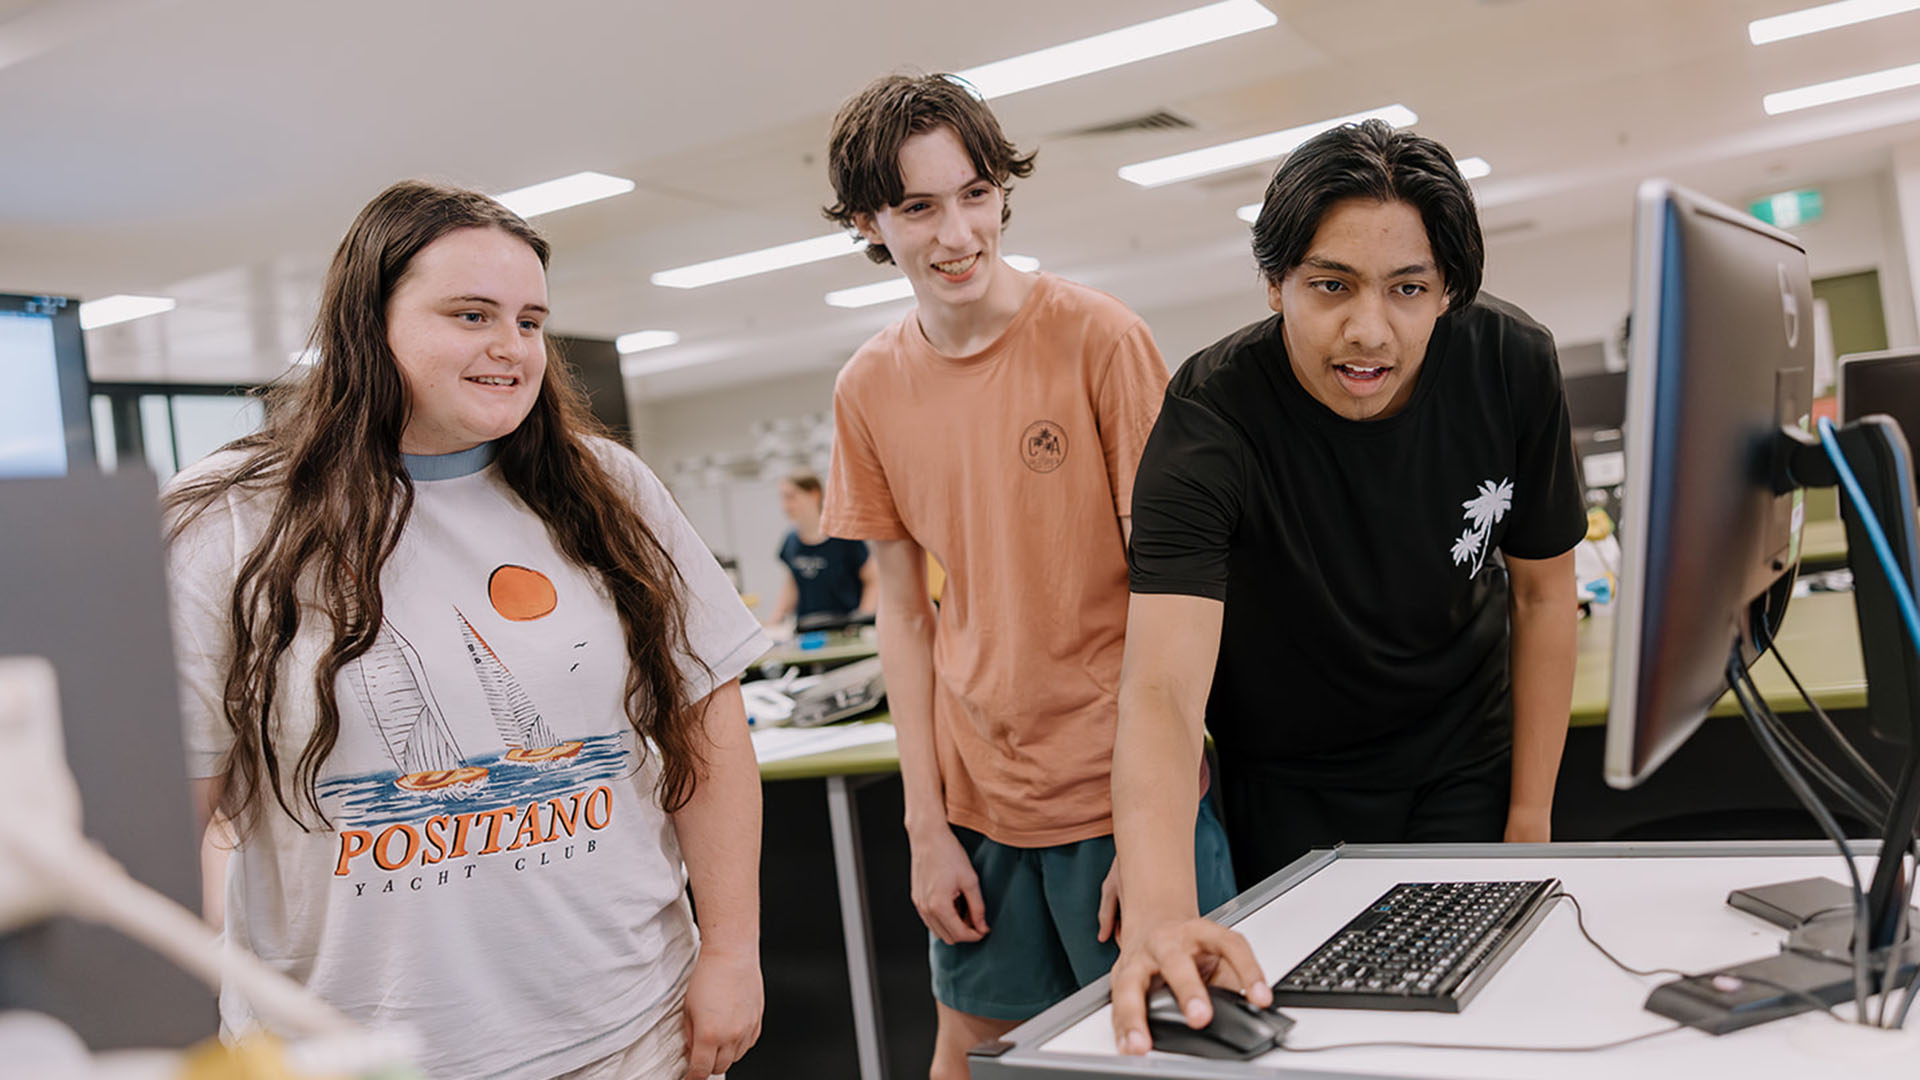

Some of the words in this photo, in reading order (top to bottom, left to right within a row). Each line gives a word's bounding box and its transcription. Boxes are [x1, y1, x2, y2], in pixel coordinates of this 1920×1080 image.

[334, 786, 613, 876] POSITANO
[355, 864, 477, 897] YACHT
[514, 840, 598, 871] CLUB
